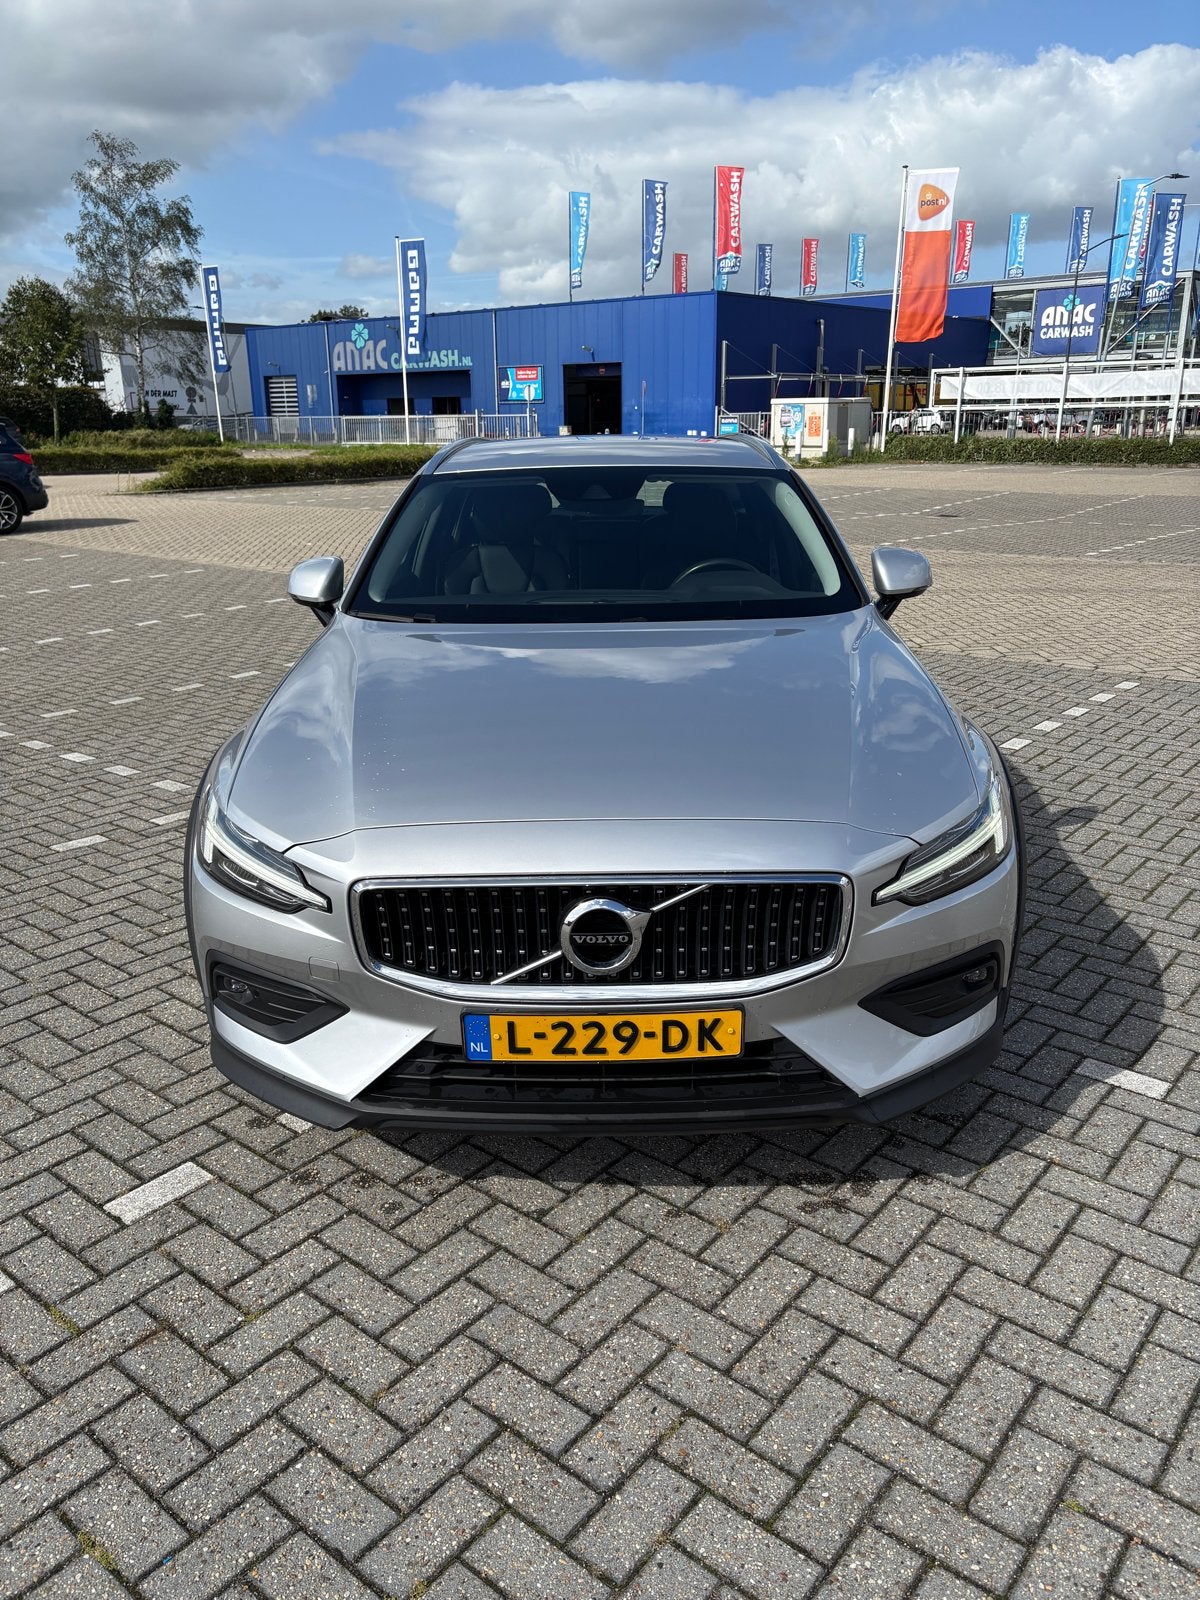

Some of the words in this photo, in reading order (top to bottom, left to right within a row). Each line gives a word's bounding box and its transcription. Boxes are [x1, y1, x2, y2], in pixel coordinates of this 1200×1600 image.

[652, 183, 664, 254] CARWASH
[730, 171, 741, 247] CARWASH
[1125, 183, 1149, 270] CARWASH
[963, 223, 973, 267] CARWASH
[1080, 209, 1091, 257] CARWASH
[1161, 198, 1182, 276] CARWASH
[856, 236, 865, 277] CARWASH
[1109, 291, 1132, 299] CAWASH
[1110, 282, 1132, 293] AAC
[1040, 325, 1093, 339] CARWASH
[1041, 303, 1097, 326] ANAC
[332, 339, 389, 371] ANAC
[162, 389, 178, 397] MAST
[572, 935, 629, 944] VOLVO
[470, 1041, 488, 1053] NL
[506, 1017, 724, 1055] L-229-DK
